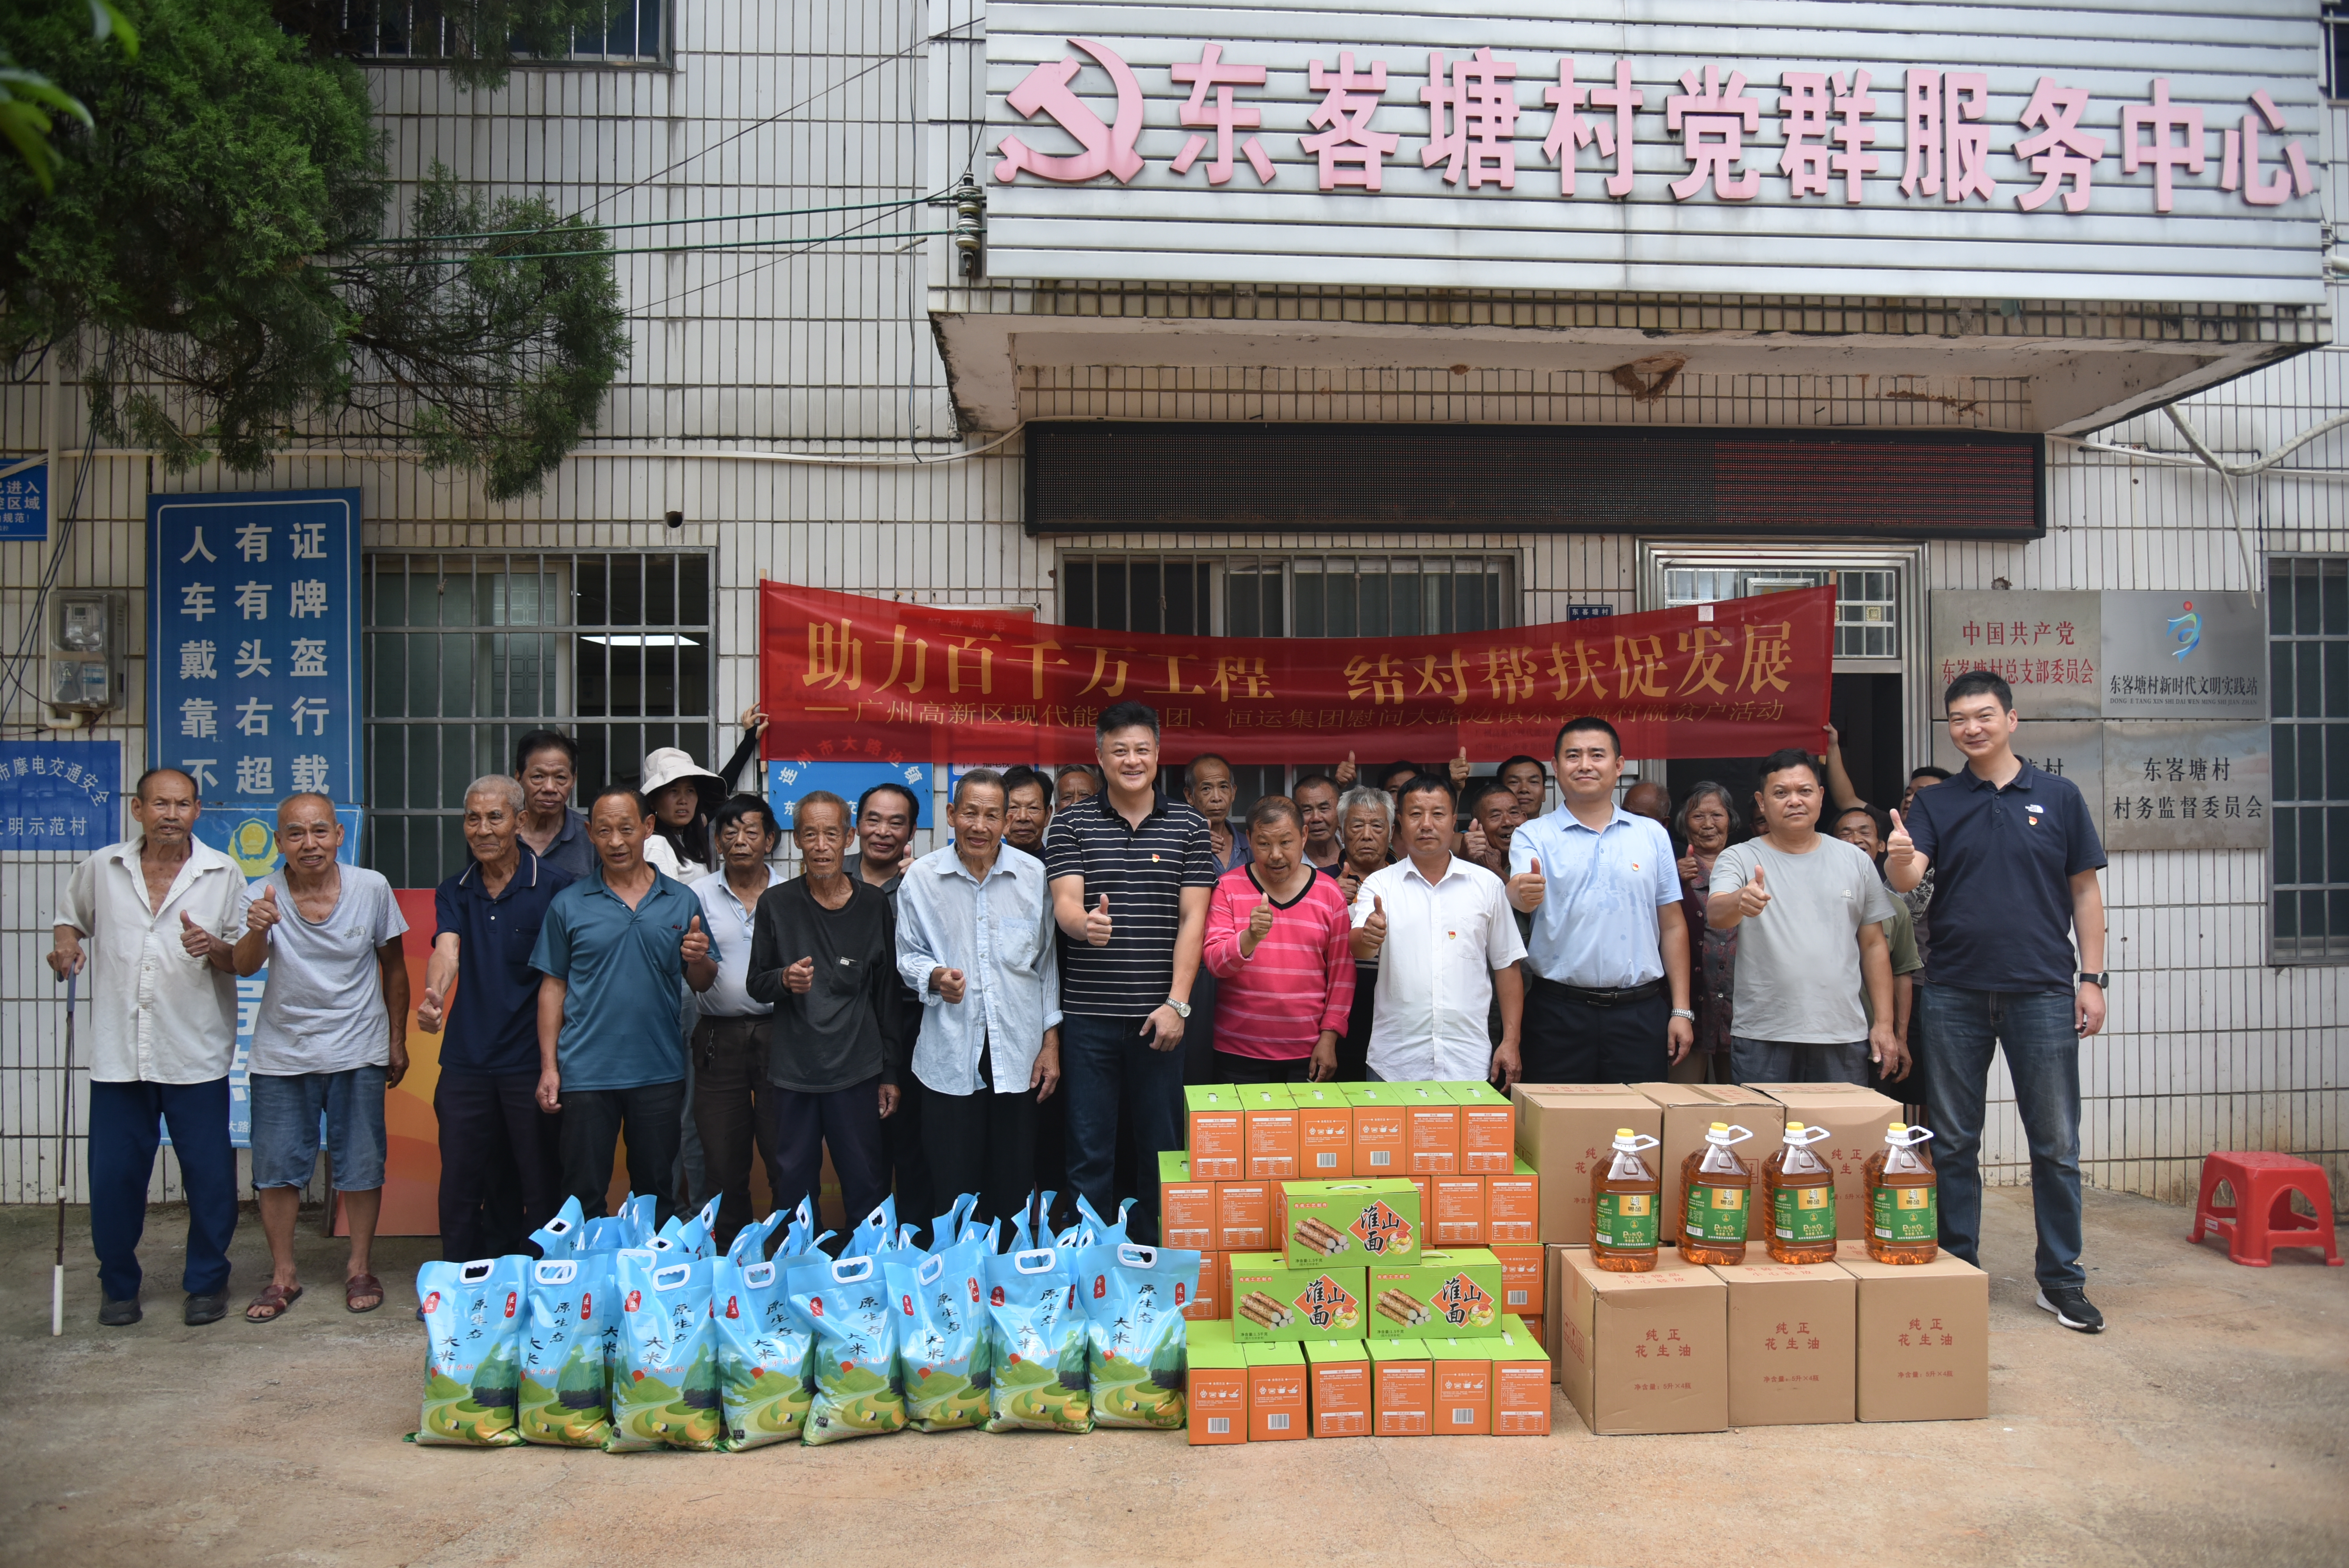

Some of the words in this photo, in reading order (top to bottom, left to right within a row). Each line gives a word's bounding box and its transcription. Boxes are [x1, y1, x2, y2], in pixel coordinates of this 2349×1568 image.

[0, 481, 40, 494] 进入
[0, 512, 29, 523] 规范!
[180, 523, 328, 564] 人有证
[180, 579, 328, 622] 车有牌
[1963, 620, 2075, 646] 中国共产党
[179, 638, 328, 680] 戴头盔
[802, 618, 1274, 703] 助力百千万工程
[1343, 621, 1792, 705] 结对帮扶促发展
[179, 696, 330, 738] 靠右行
[182, 754, 330, 796] 不超载
[2113, 795, 2262, 819] 村务监督委员会
[0, 817, 87, 836] 明示范村
[229, 1121, 251, 1133] 大路
[1831, 1149, 1862, 1160] 纯正
[1360, 1205, 1399, 1230] 淮山
[1097, 1278, 1103, 1294] 粤盈
[1177, 1286, 1183, 1301] 连山
[1306, 1279, 1346, 1304] 淮山
[1443, 1277, 1482, 1302] 淮山
[507, 1296, 515, 1311] 连山
[937, 1293, 961, 1335] 原生态
[1040, 1289, 1059, 1327] 原生态
[1137, 1284, 1157, 1323] 原生态
[466, 1299, 488, 1340] 原生态
[549, 1302, 570, 1343] 原生态
[672, 1304, 692, 1345] 原生态
[766, 1300, 793, 1339] 原生态
[858, 1297, 884, 1336] 原生态
[1776, 1322, 1810, 1335] 纯正
[1909, 1318, 1943, 1331] 纯正
[602, 1326, 618, 1354] 大米
[1016, 1325, 1039, 1349] 大米
[1112, 1317, 1134, 1344] 大米
[1646, 1328, 1681, 1341] 纯正
[1898, 1333, 1952, 1346] 花生油
[435, 1336, 461, 1362] 大米
[641, 1336, 667, 1364] 大米
[752, 1339, 778, 1360] 大米
[847, 1333, 868, 1355] 大米
[923, 1336, 946, 1360] 大米
[1635, 1344, 1691, 1358] 花生油
[1765, 1337, 1820, 1350] 花生油
